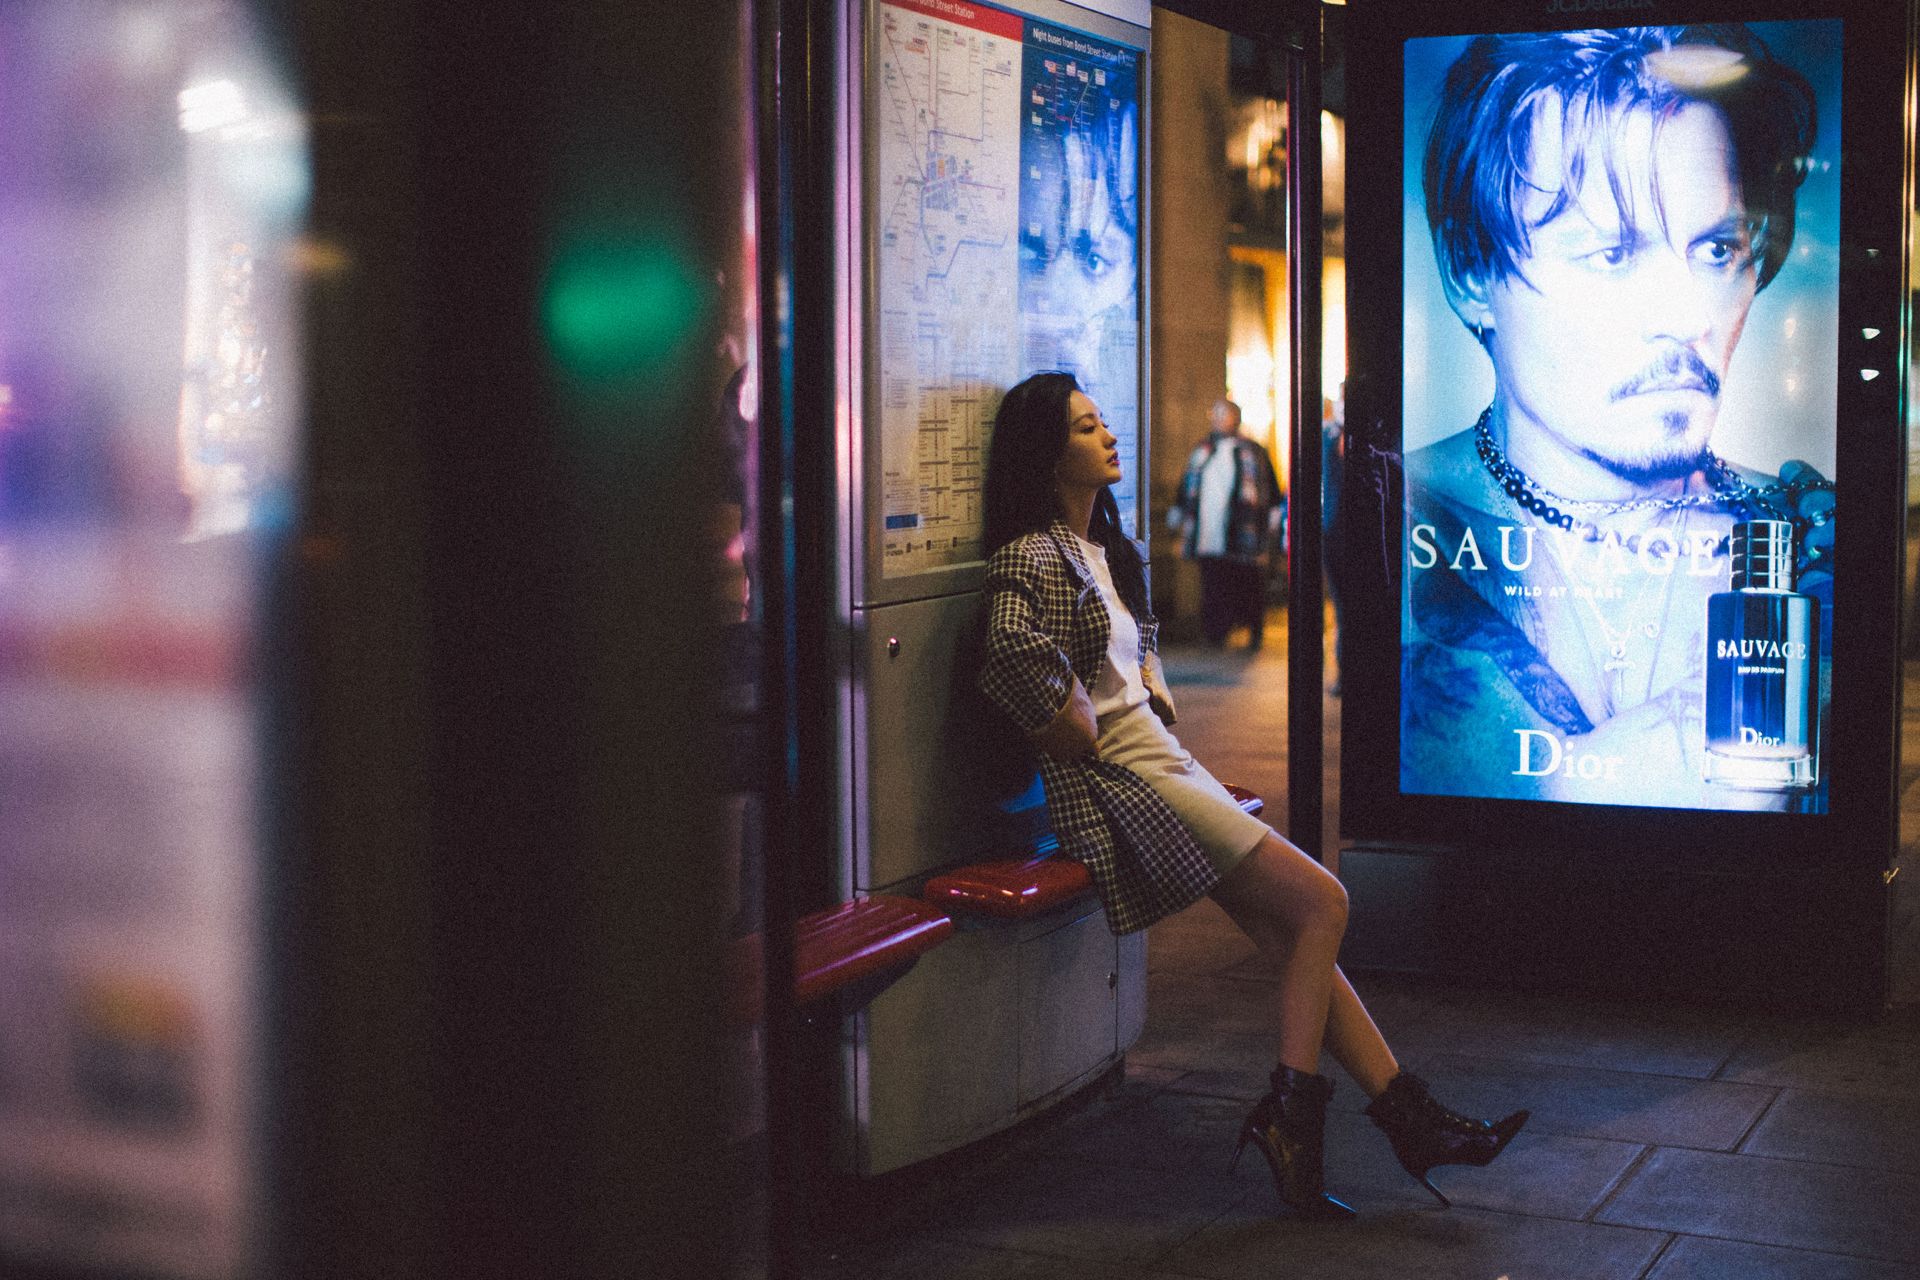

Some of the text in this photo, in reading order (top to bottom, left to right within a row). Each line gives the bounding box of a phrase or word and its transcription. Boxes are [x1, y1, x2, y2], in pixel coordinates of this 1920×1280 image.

[936, 2, 954, 15] Street
[955, 4, 975, 20] Station
[1032, 27, 1047, 43] Night
[1047, 32, 1062, 46] buses
[1062, 36, 1074, 48] from
[1074, 40, 1087, 53] Bond
[1087, 44, 1101, 56] Street
[1101, 49, 1118, 62] Station
[1410, 523, 1721, 576] SAUVAGE
[1504, 585, 1543, 598] WILD
[1549, 585, 1567, 598] AT
[1717, 639, 1807, 660] SAUVAGE
[1738, 726, 1781, 747] Dior
[1510, 728, 1625, 780] Dior
